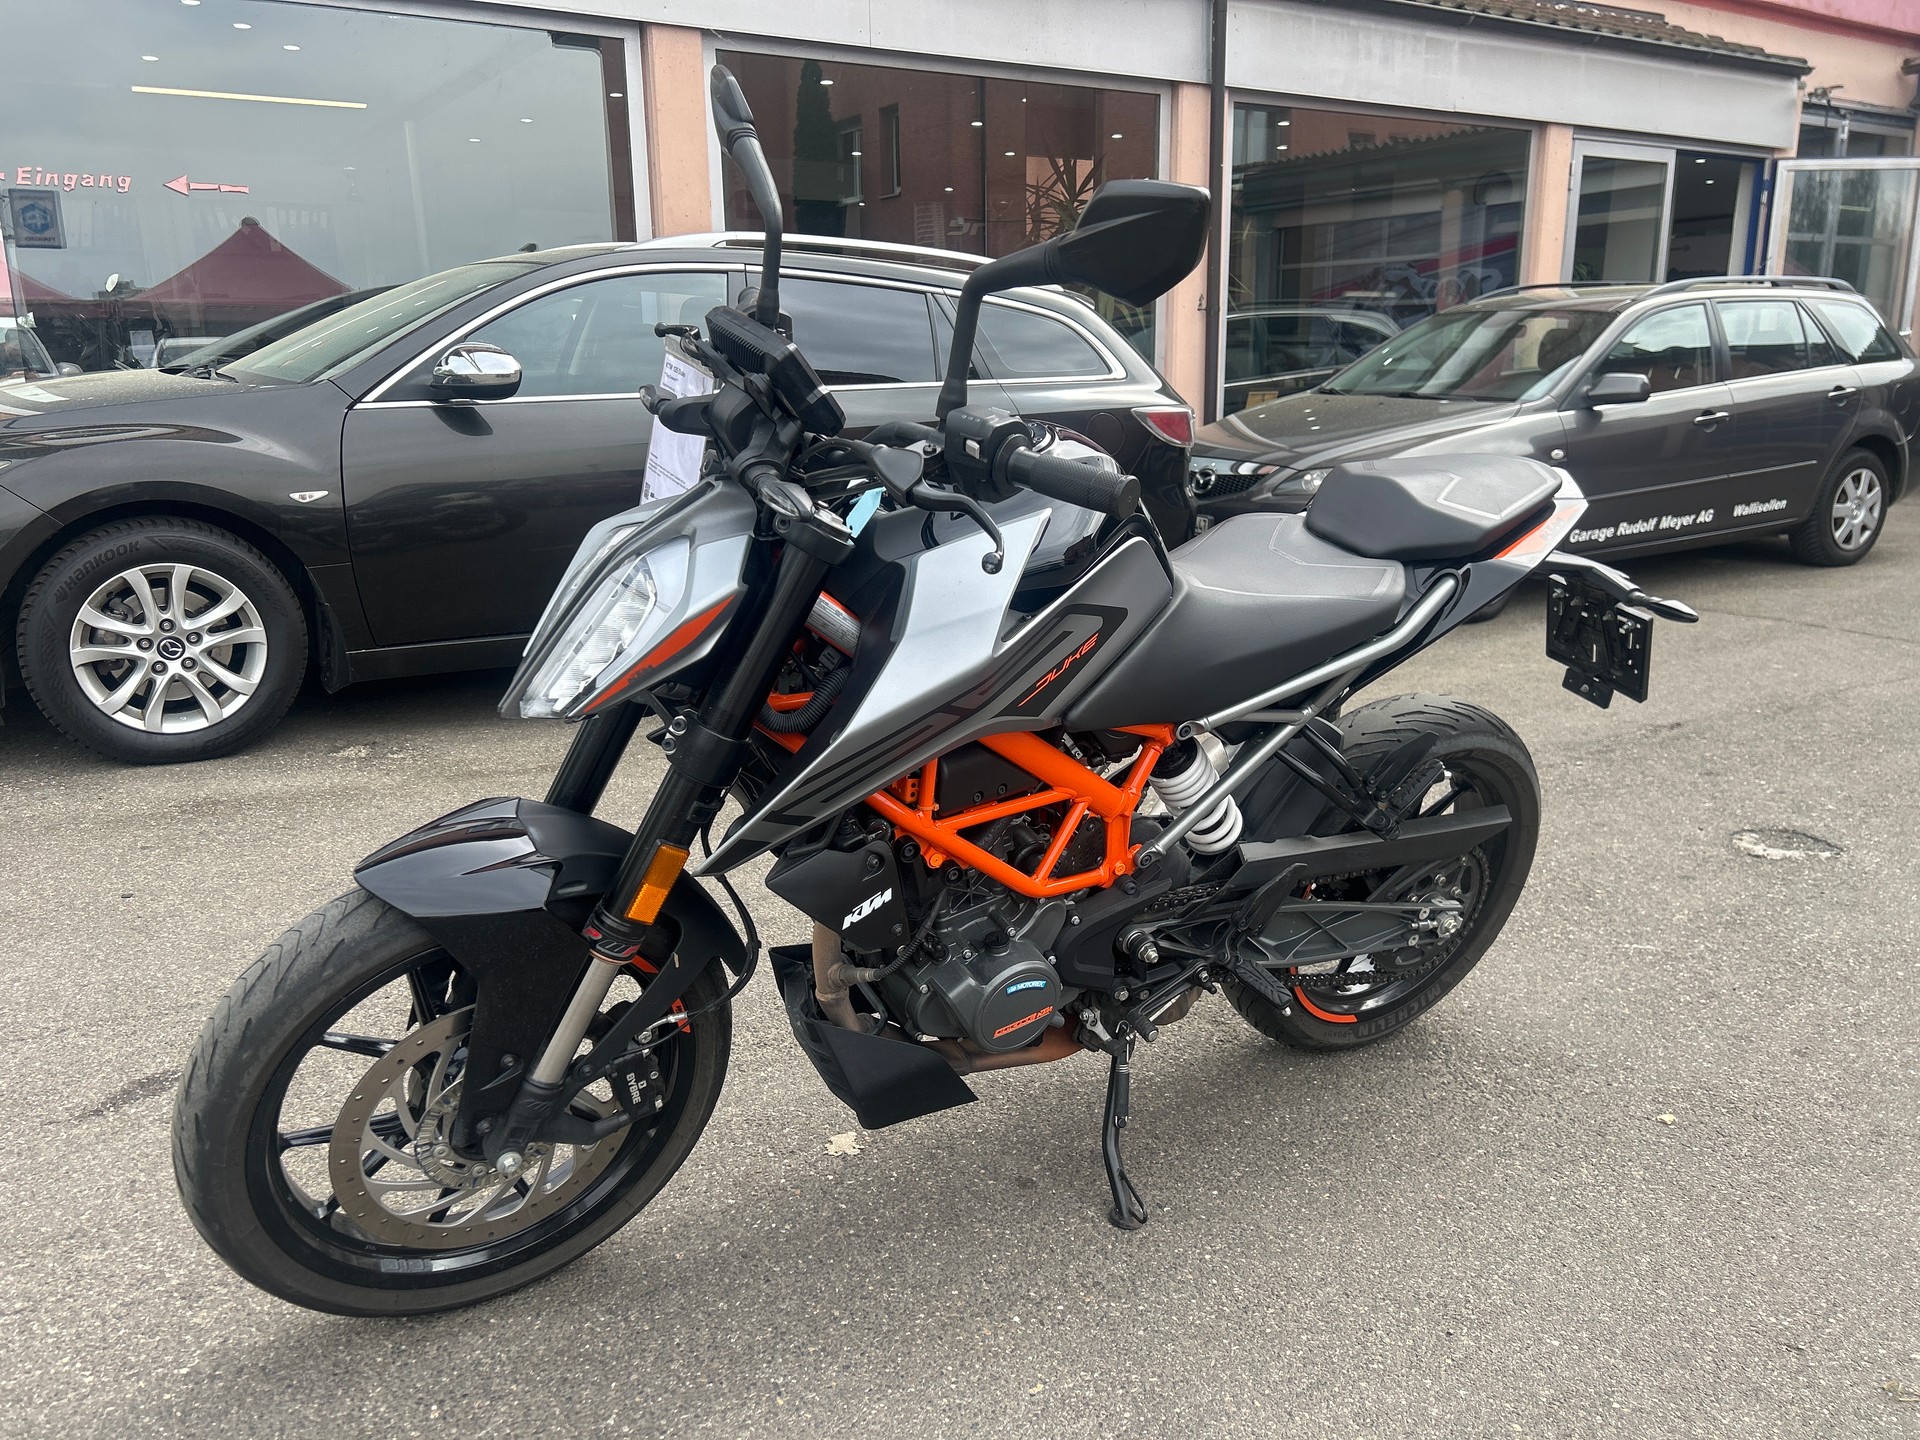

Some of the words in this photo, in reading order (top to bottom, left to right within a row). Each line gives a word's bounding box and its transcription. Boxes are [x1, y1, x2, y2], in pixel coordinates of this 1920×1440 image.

[16, 166, 132, 193] Eingang
[1569, 526, 1615, 543] Garage
[1617, 516, 1659, 537] Rudolf
[1659, 514, 1696, 531] Meyer
[1696, 508, 1715, 524] AG
[1732, 498, 1788, 518] Wallisellen
[1018, 632, 1099, 707] DUKE
[842, 887, 892, 931] KTM
[1358, 984, 1442, 1037] MICHELIN
[626, 1072, 642, 1105] BYBRE
